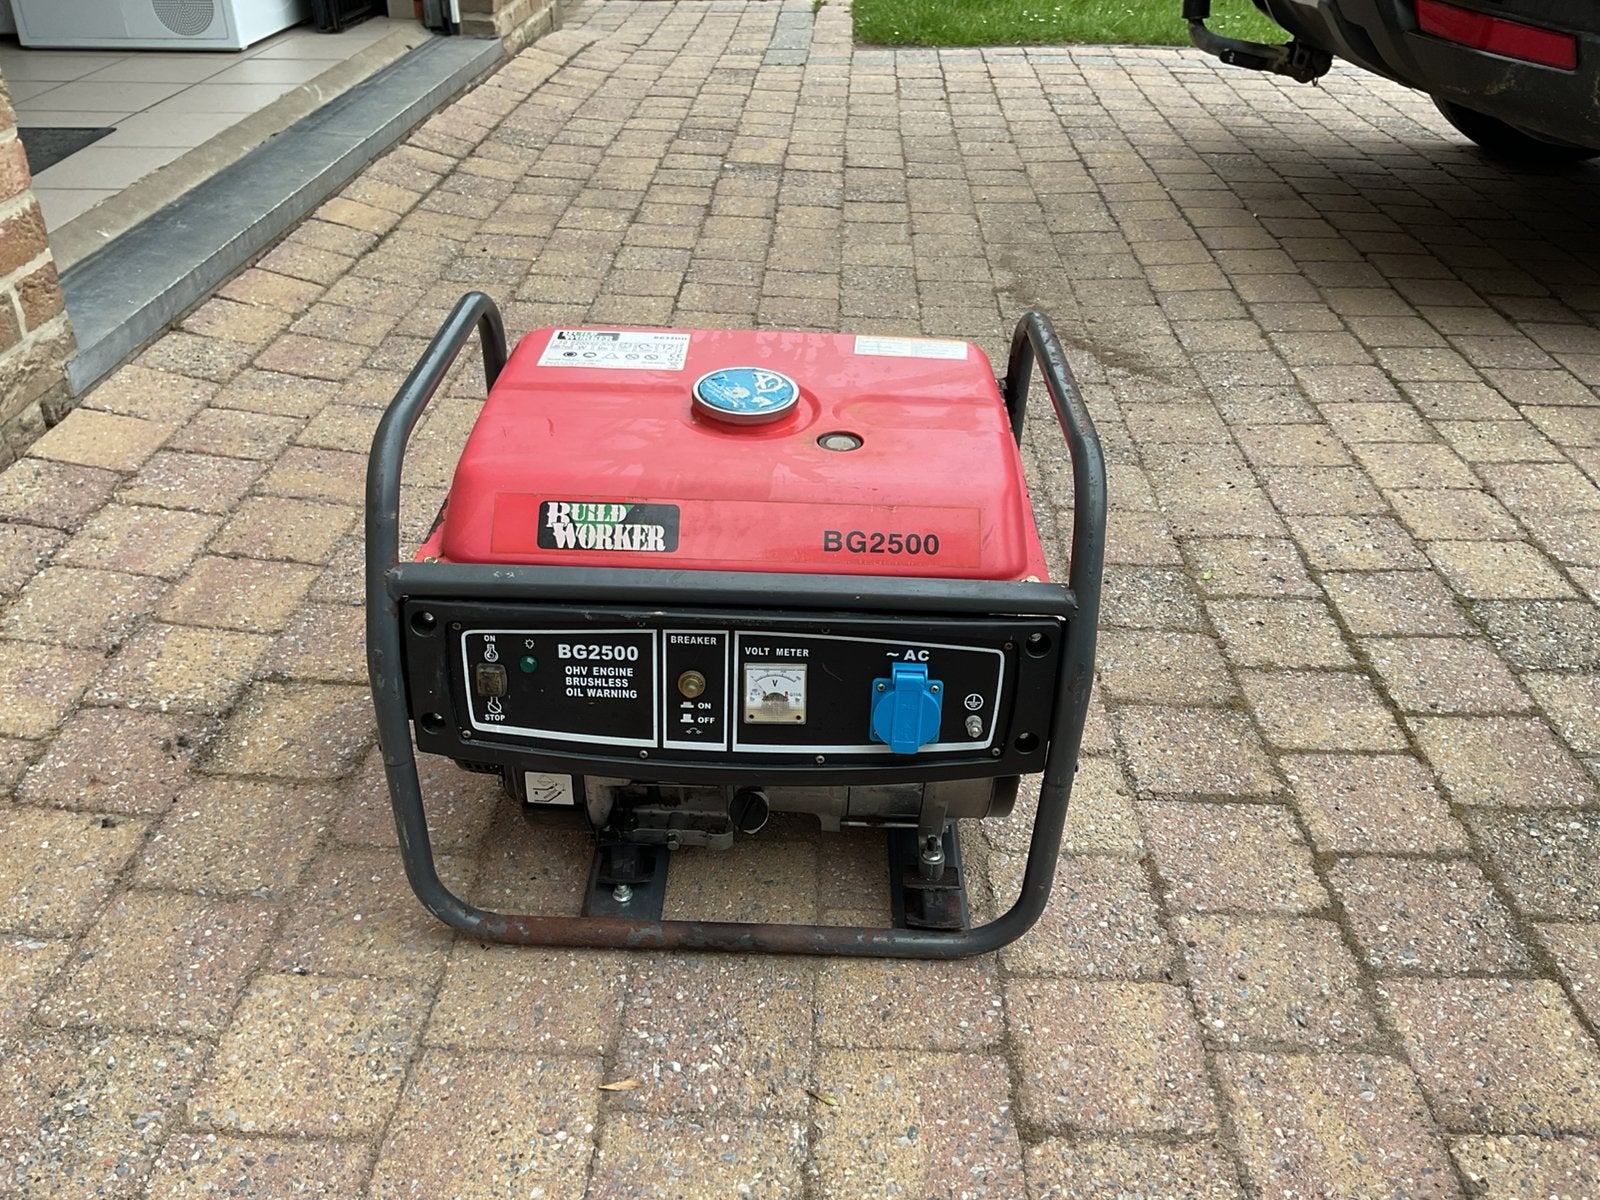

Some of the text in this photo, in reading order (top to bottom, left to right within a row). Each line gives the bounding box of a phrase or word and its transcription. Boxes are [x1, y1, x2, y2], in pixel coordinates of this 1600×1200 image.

[552, 522, 666, 551] WORKER
[823, 530, 939, 555] BG2500
[670, 636, 717, 645] BREAKER
[557, 643, 639, 661] BG2500
[744, 647, 809, 657] VOLT METER
[903, 650, 929, 661] AC
[565, 666, 634, 677] OHV ENGINE
[565, 677, 629, 687] BRUSHLESS
[566, 688, 638, 699] OIL WARNING
[697, 702, 712, 710] ON
[484, 713, 506, 721] STOP
